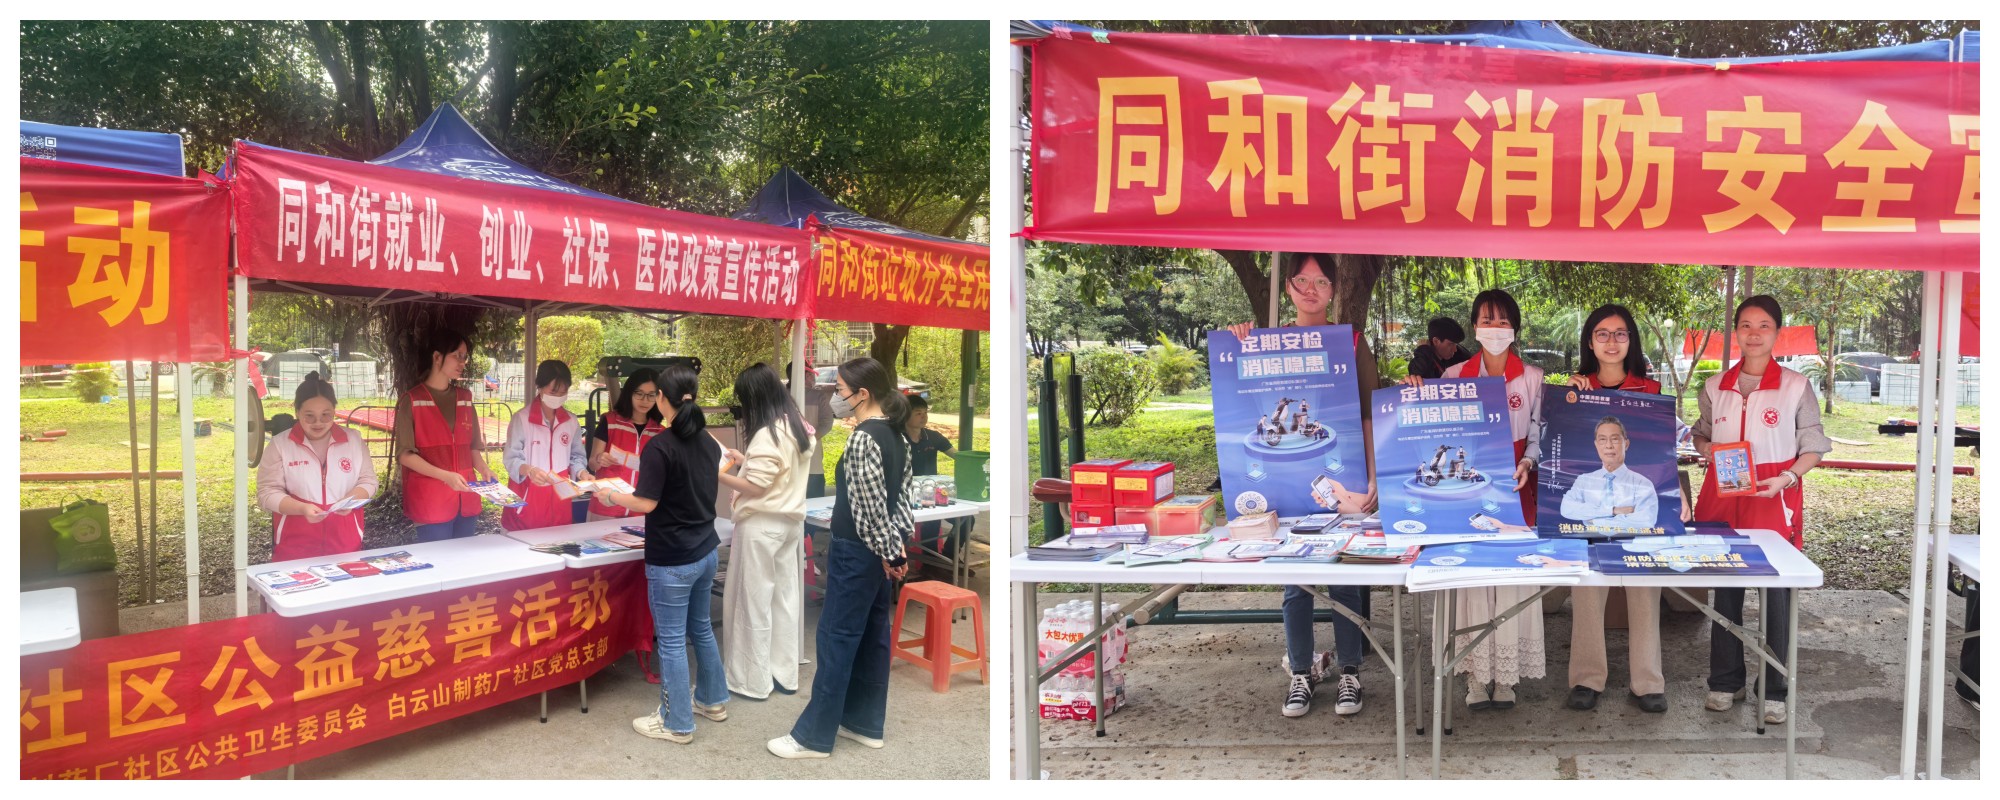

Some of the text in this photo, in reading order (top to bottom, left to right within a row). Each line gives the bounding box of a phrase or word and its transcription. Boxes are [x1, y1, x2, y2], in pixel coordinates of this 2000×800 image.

[20, 191, 170, 327] 动
[278, 178, 800, 306] 同和街就业、创业、社保、医保政策宣传活动
[1241, 331, 1322, 353] 定期安检
[1242, 355, 1325, 377] 消除隐患
[1400, 382, 1478, 402] 定期安检
[1402, 405, 1480, 425] 消除隐患
[20, 570, 612, 759] 社区公益慈善活动
[31, 636, 609, 780] 厂社区公共卫生委员会 白云山制药厂社区党总支部
